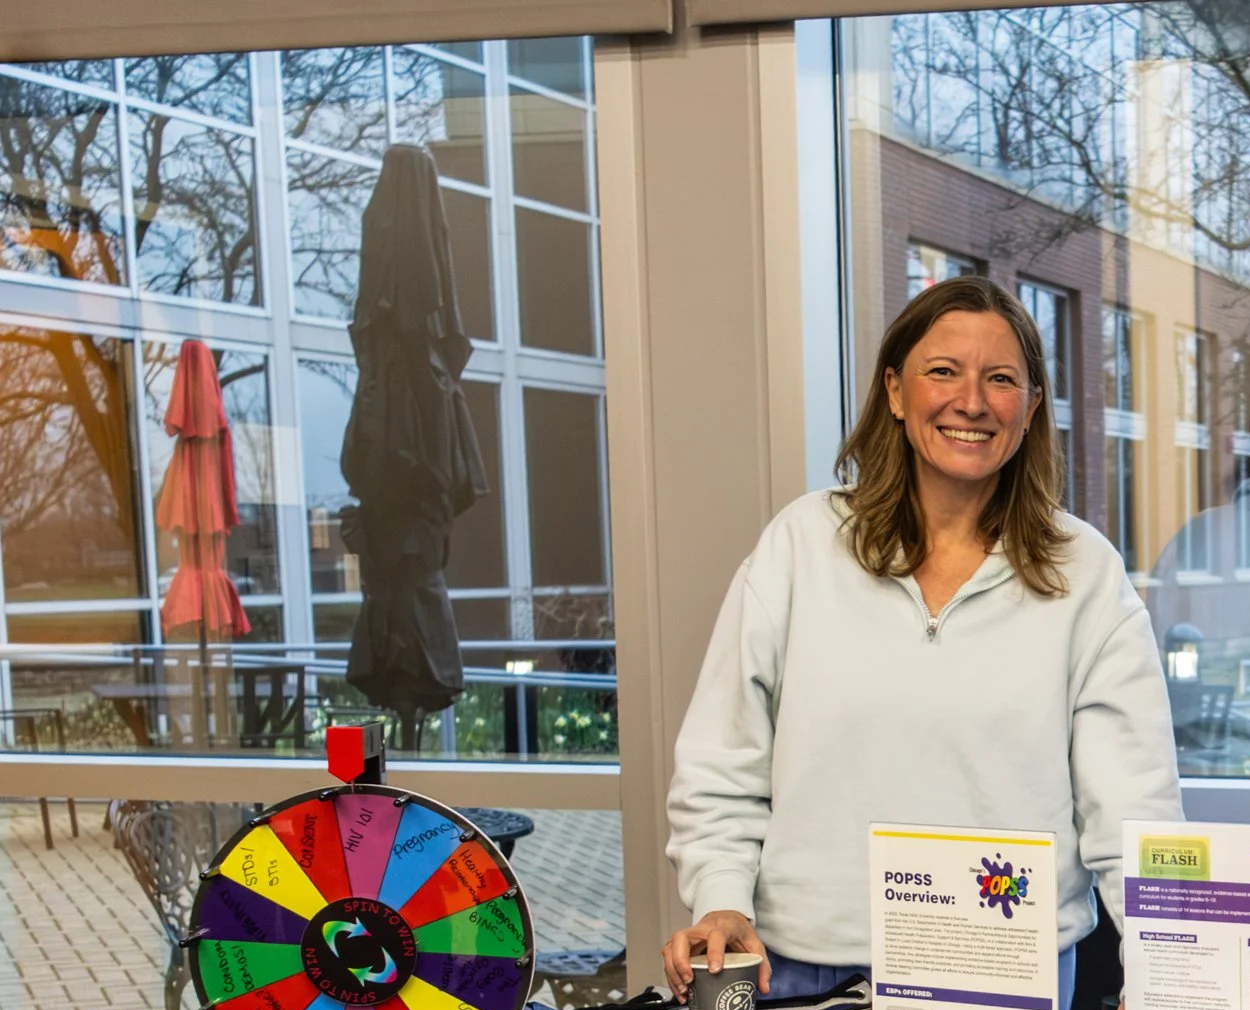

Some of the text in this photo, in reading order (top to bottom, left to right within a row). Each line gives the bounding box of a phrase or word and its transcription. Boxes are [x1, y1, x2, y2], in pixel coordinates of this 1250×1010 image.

[344, 808, 374, 852] HIV 101
[393, 821, 461, 860] Pregnancy
[1152, 854, 1198, 866] FLASH
[884, 871, 932, 886] POPSS
[982, 875, 1029, 898] POPSS
[884, 888, 956, 906] Overview:
[343, 900, 415, 958] SPIN TO WIN
[305, 947, 377, 1002] SPIN TO WIN
